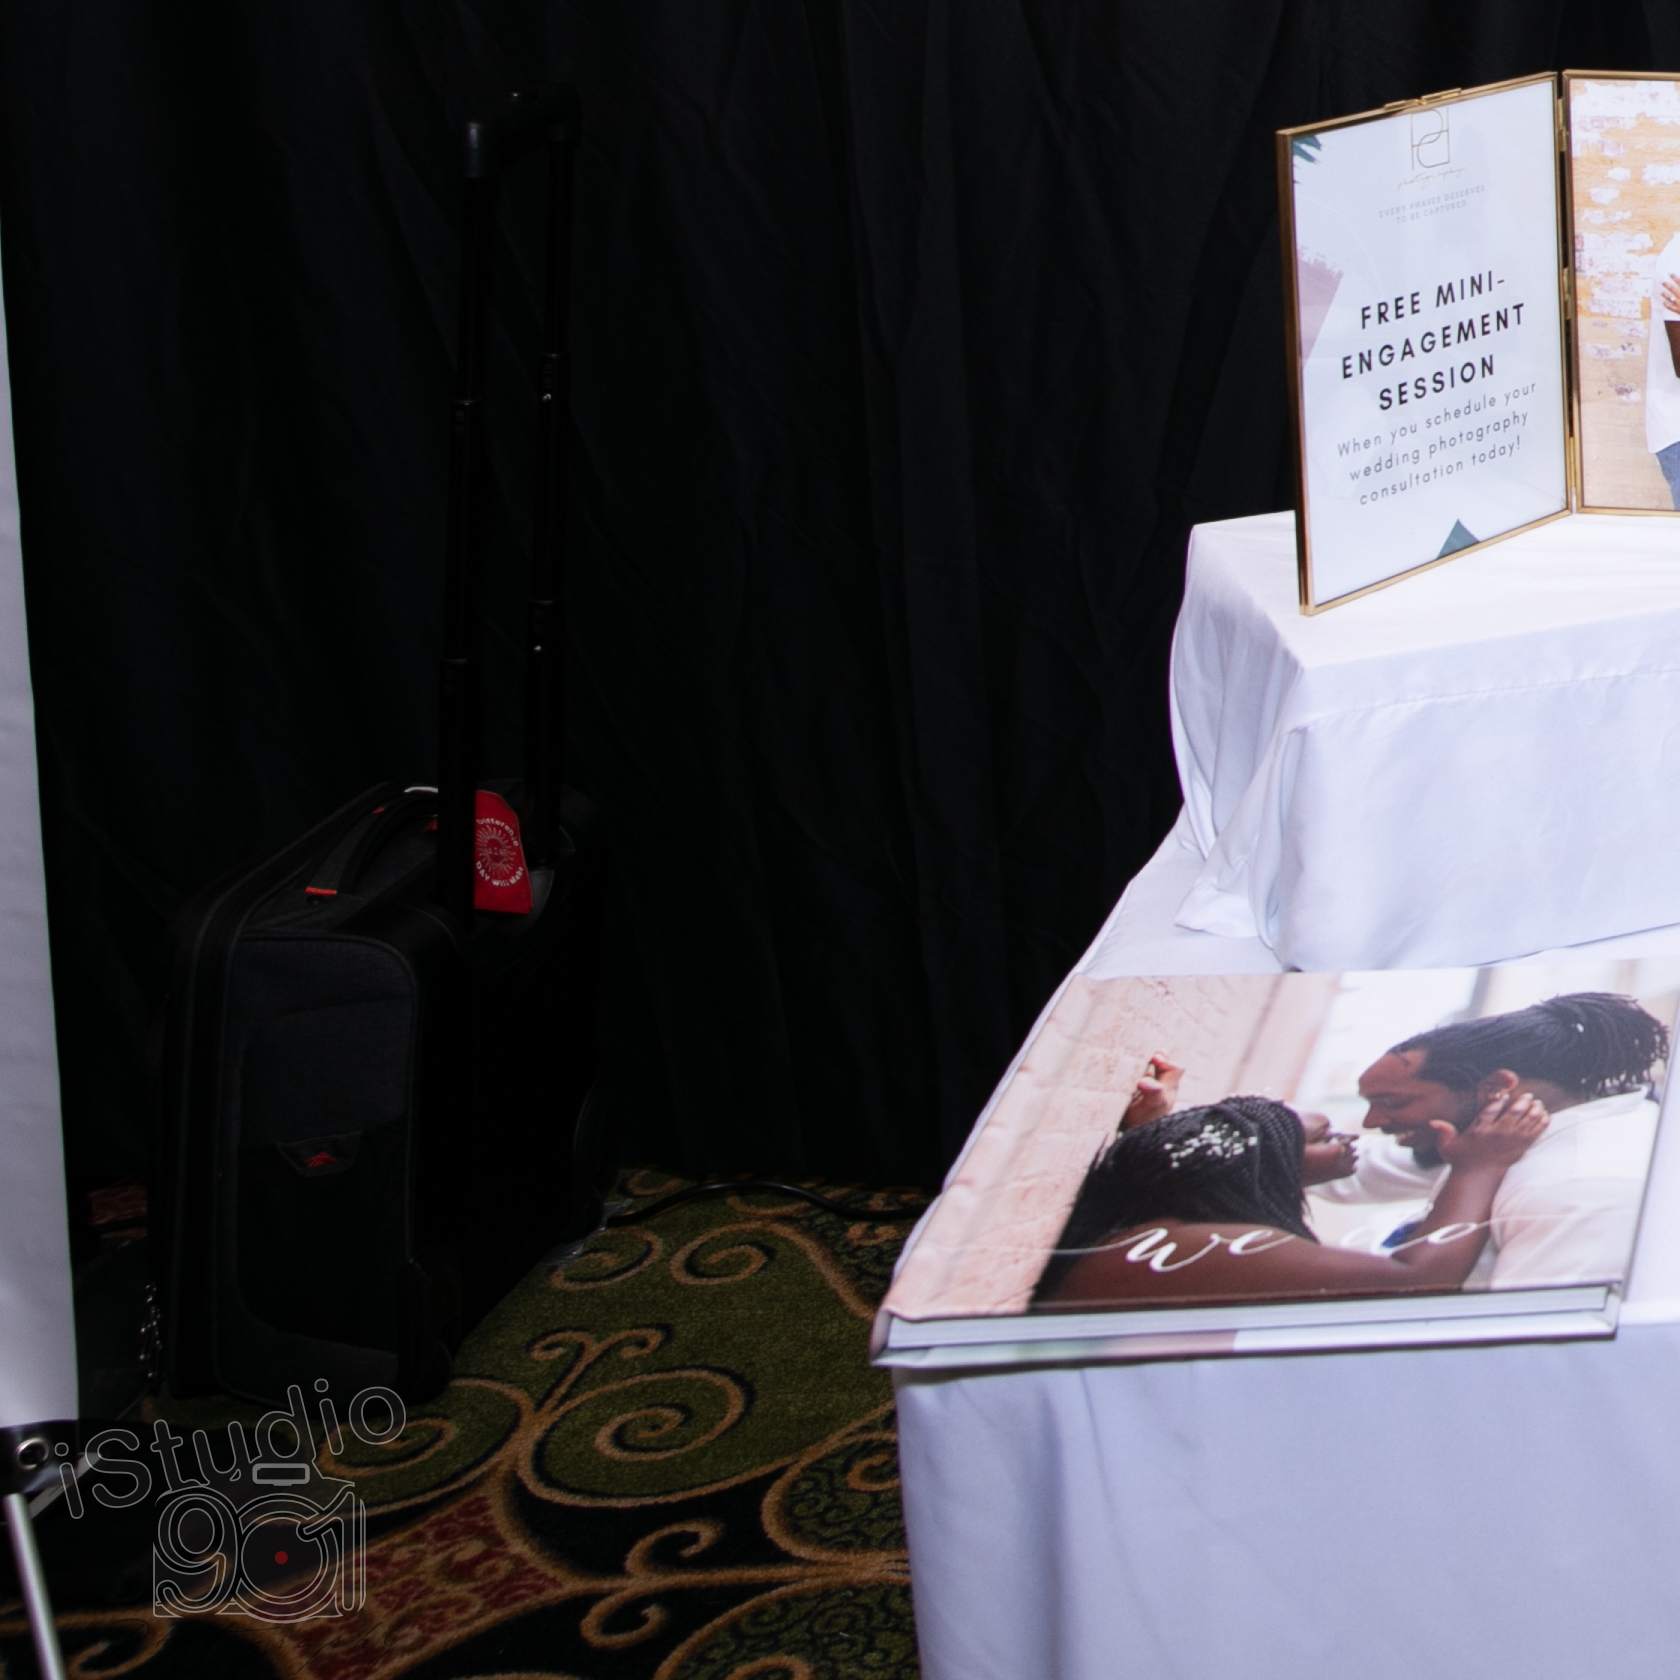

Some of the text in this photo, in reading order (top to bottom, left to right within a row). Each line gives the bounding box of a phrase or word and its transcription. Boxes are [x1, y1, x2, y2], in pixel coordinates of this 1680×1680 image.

[1378, 184, 1485, 219] EVERY PHASES DESERVES
[1423, 199, 1468, 218] CAPTURED
[1361, 270, 1506, 330] FREE MINI-
[1342, 302, 1525, 379] ENGAGEMENT
[1378, 354, 1494, 411] SESSION
[1337, 381, 1536, 458] When you schedule your
[1349, 410, 1529, 482] wedding photography
[1359, 434, 1522, 506] consultation today!
[1060, 1225, 1296, 1273] we
